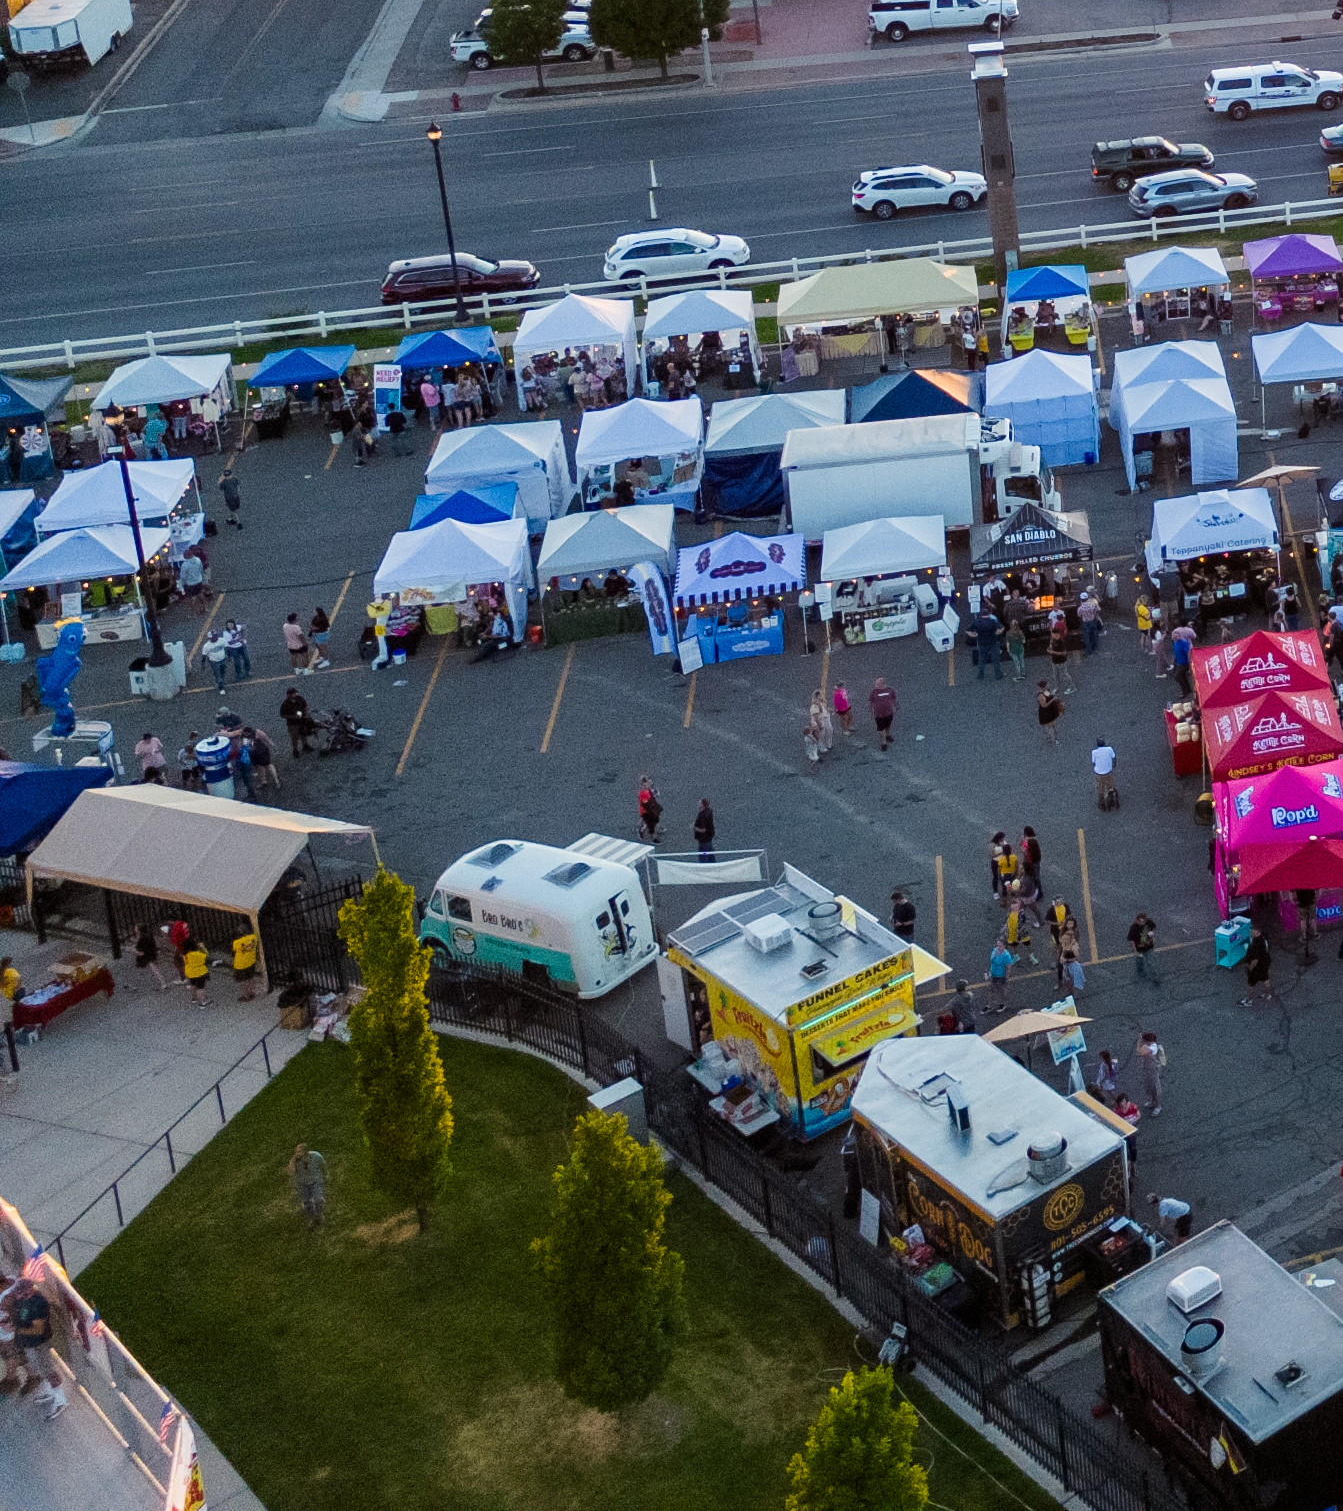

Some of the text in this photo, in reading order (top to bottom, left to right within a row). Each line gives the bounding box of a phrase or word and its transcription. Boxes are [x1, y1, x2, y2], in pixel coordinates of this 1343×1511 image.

[1004, 529, 1056, 545] SAN DIABLO
[1172, 536, 1267, 556] Teppanyaki Catering
[1015, 556, 1038, 566] FILLED
[1039, 552, 1073, 562] CHURROS
[1271, 804, 1319, 826] Pop'd
[481, 908, 498, 925] BRO
[797, 981, 850, 1012] FUNNEL
[854, 957, 898, 983] CAKES
[835, 1010, 850, 1022] THAT
[1053, 1194, 1075, 1219] TCC
